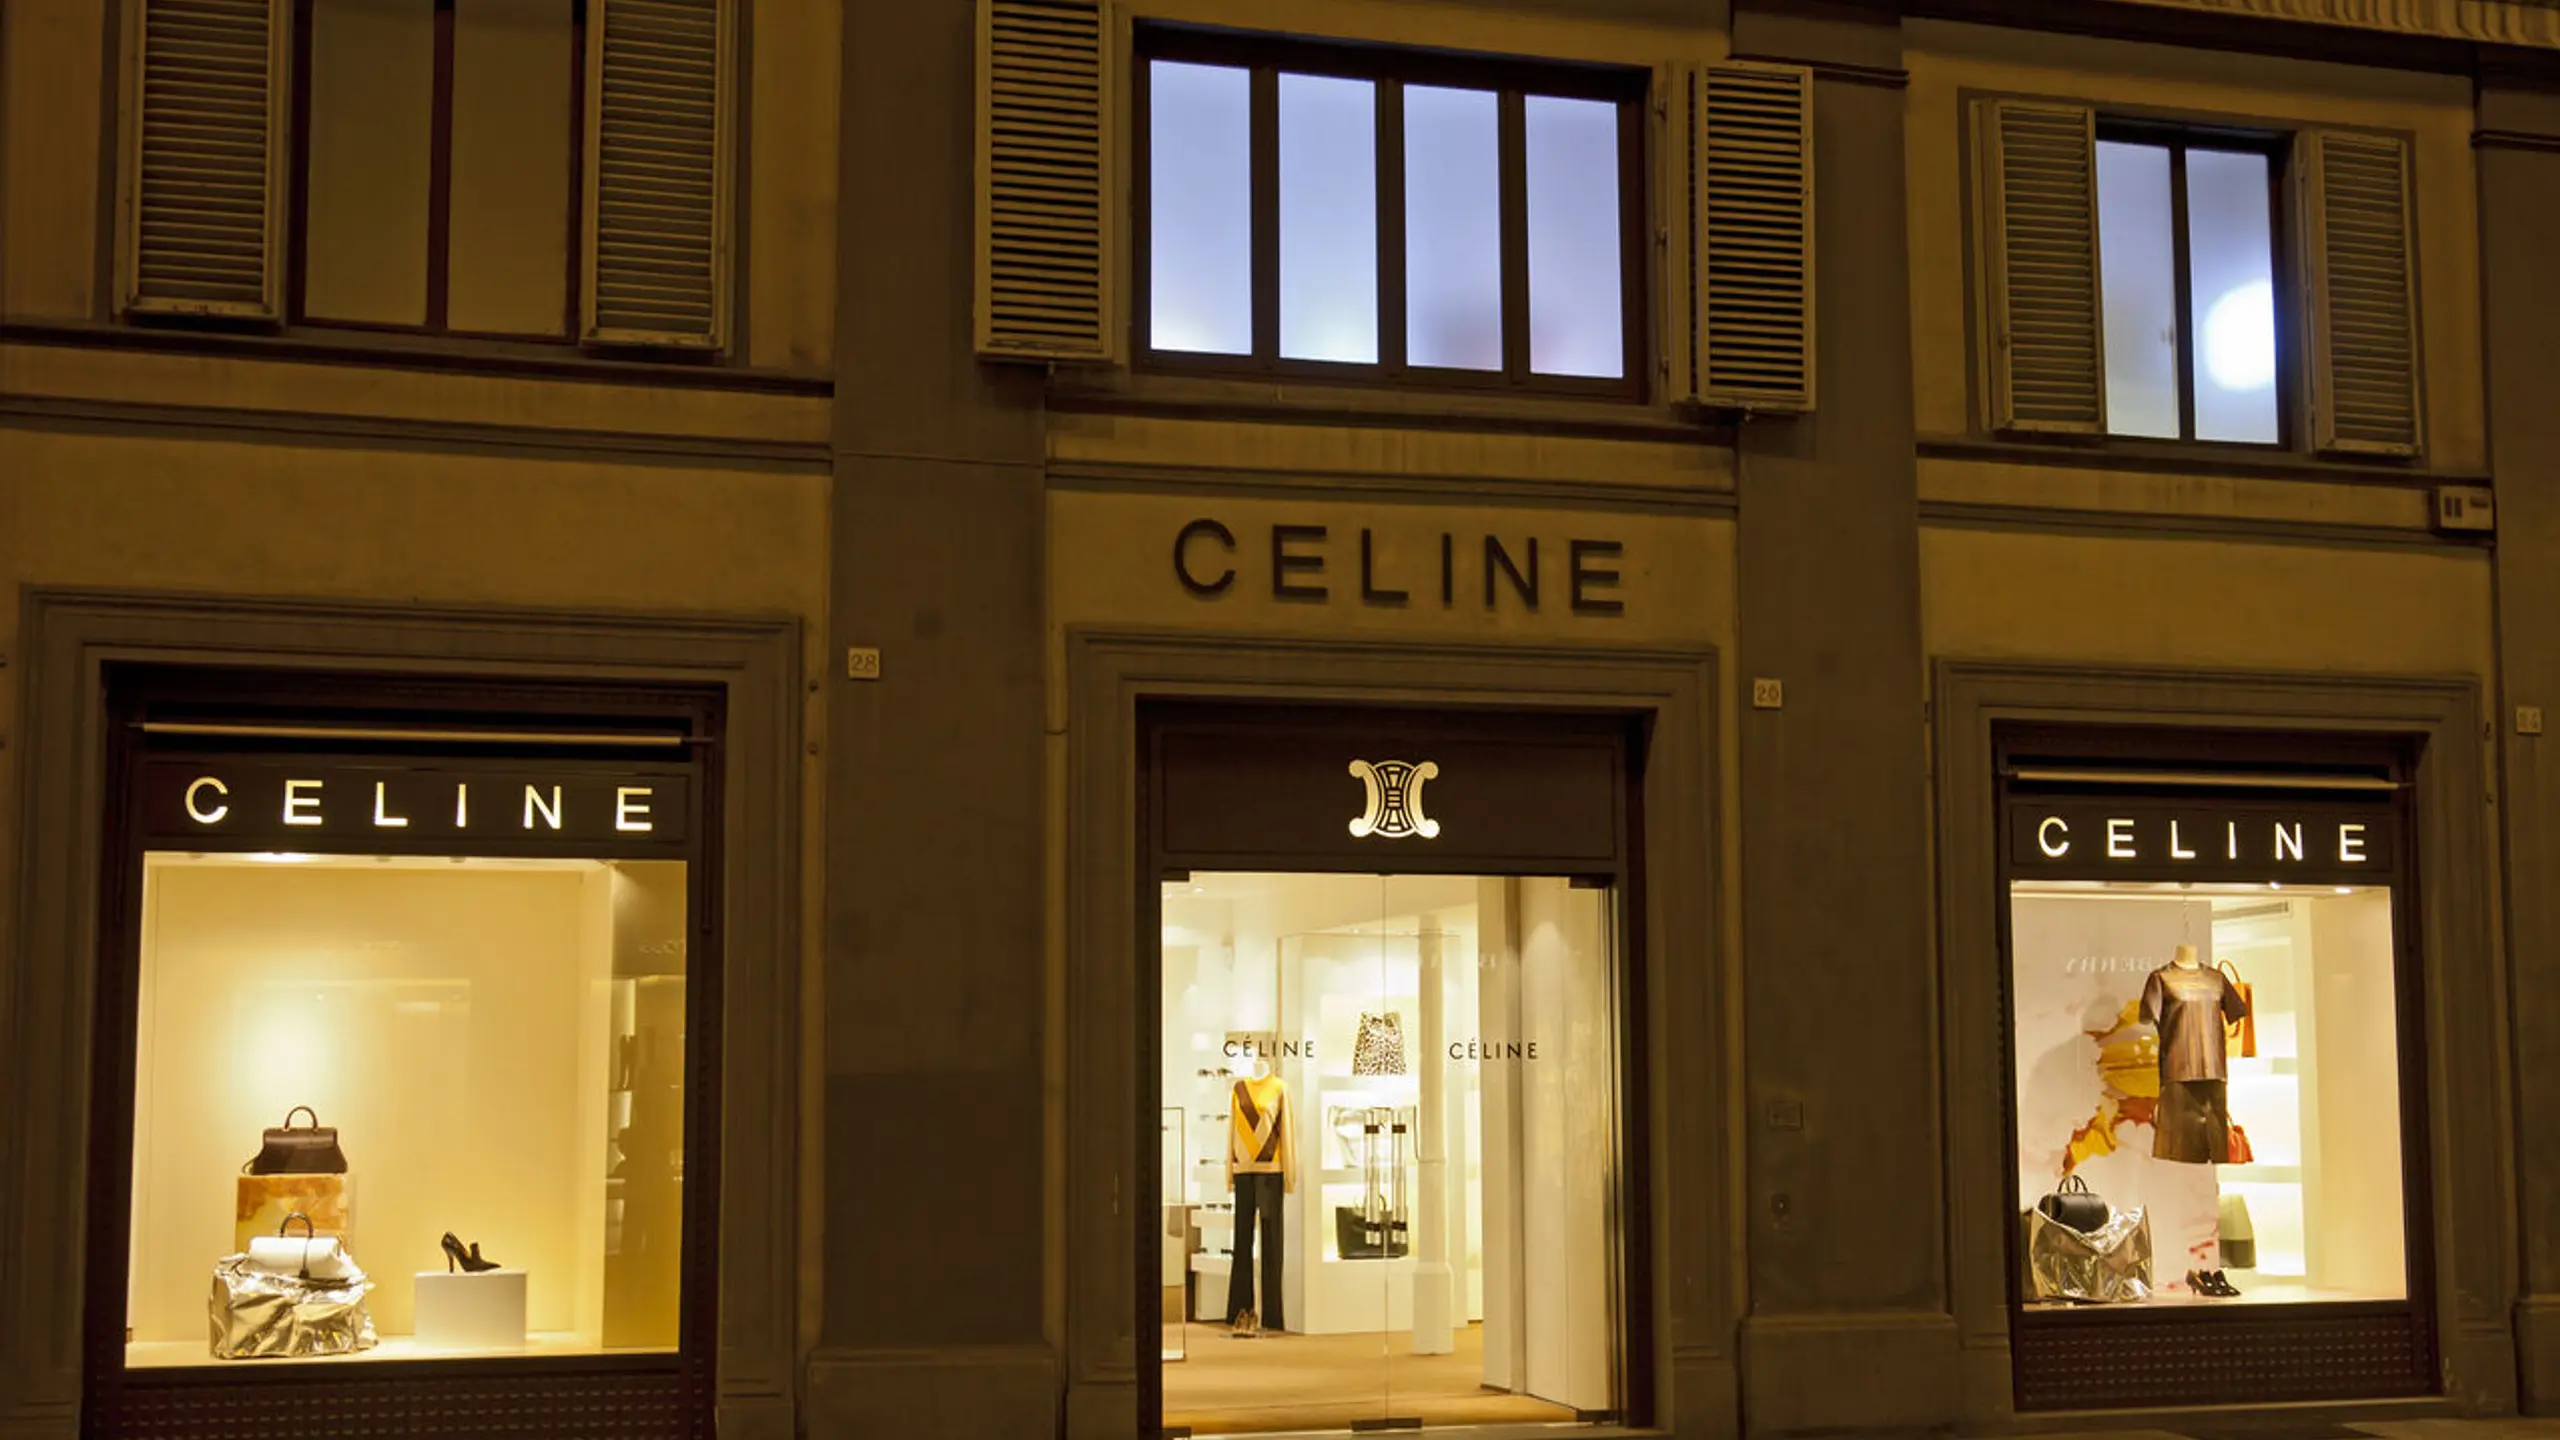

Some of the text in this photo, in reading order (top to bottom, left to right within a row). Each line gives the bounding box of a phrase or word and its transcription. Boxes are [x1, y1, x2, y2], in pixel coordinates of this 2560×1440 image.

[1174, 517, 1625, 613] CELINE
[850, 653, 877, 672] 28
[185, 777, 653, 831] CELINE
[2038, 816, 2366, 861] CELINE
[1222, 1034, 1315, 1058] CÉLINE
[1448, 1037, 1538, 1060] CÉLINE
